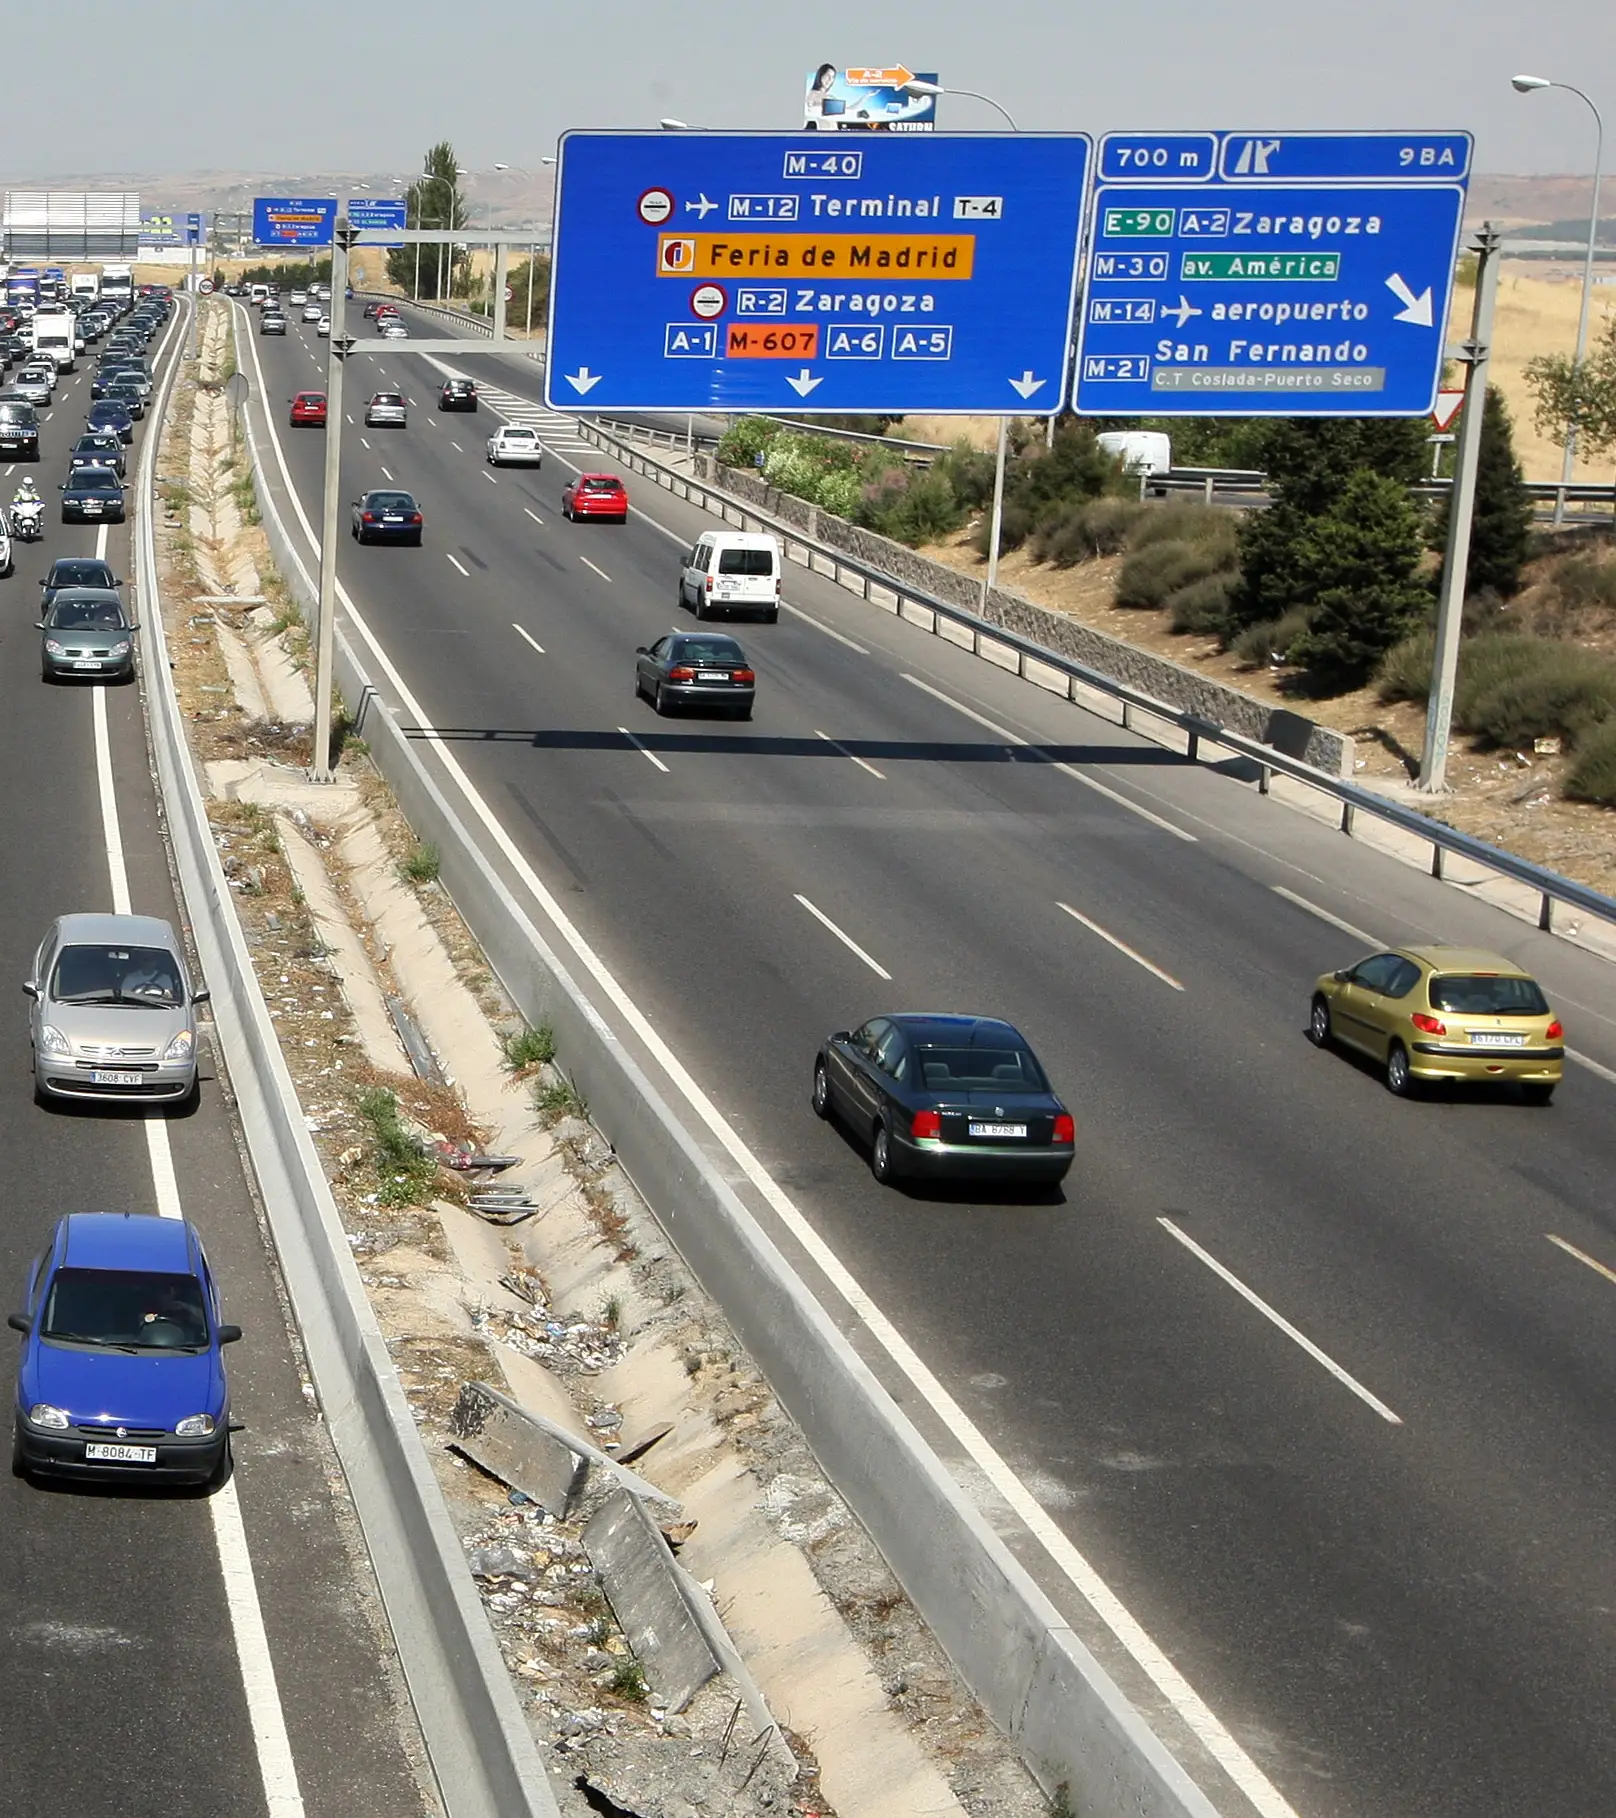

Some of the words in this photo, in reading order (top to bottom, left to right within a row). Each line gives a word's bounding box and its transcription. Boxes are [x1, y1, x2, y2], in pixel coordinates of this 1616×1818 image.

[787, 156, 857, 176] M-40
[1116, 148, 1169, 167] 700
[1179, 151, 1200, 167] m
[731, 197, 794, 218] M-12
[810, 194, 940, 218] Terminal
[957, 198, 999, 218] T-4
[1106, 212, 1172, 232] E-90
[1182, 212, 1228, 233] A-2
[1232, 211, 1382, 240] Zaragoza
[709, 242, 791, 268] Feria
[801, 243, 836, 268] de
[848, 244, 958, 270] Madrid
[1096, 256, 1166, 277] M-30
[1183, 258, 1214, 277] av.
[1227, 255, 1337, 277] América
[741, 291, 784, 314] R-2
[794, 289, 936, 318] Zaragoza
[1093, 302, 1152, 322] M-14
[1210, 299, 1369, 326] aeropuerto
[669, 331, 713, 352] A-1
[729, 331, 816, 352] M-607
[831, 332, 879, 353] A-6
[896, 332, 947, 353] A-5
[1154, 339, 1210, 363] San
[1228, 339, 1369, 363] Fernando
[1087, 359, 1147, 378] M-21
[1191, 370, 1324, 388] Coslada-Puerto
[1330, 371, 1374, 387] Seco
[86, 1444, 96, 1457] M
[101, 1445, 134, 1460] 8084
[139, 1447, 155, 1461] TF
